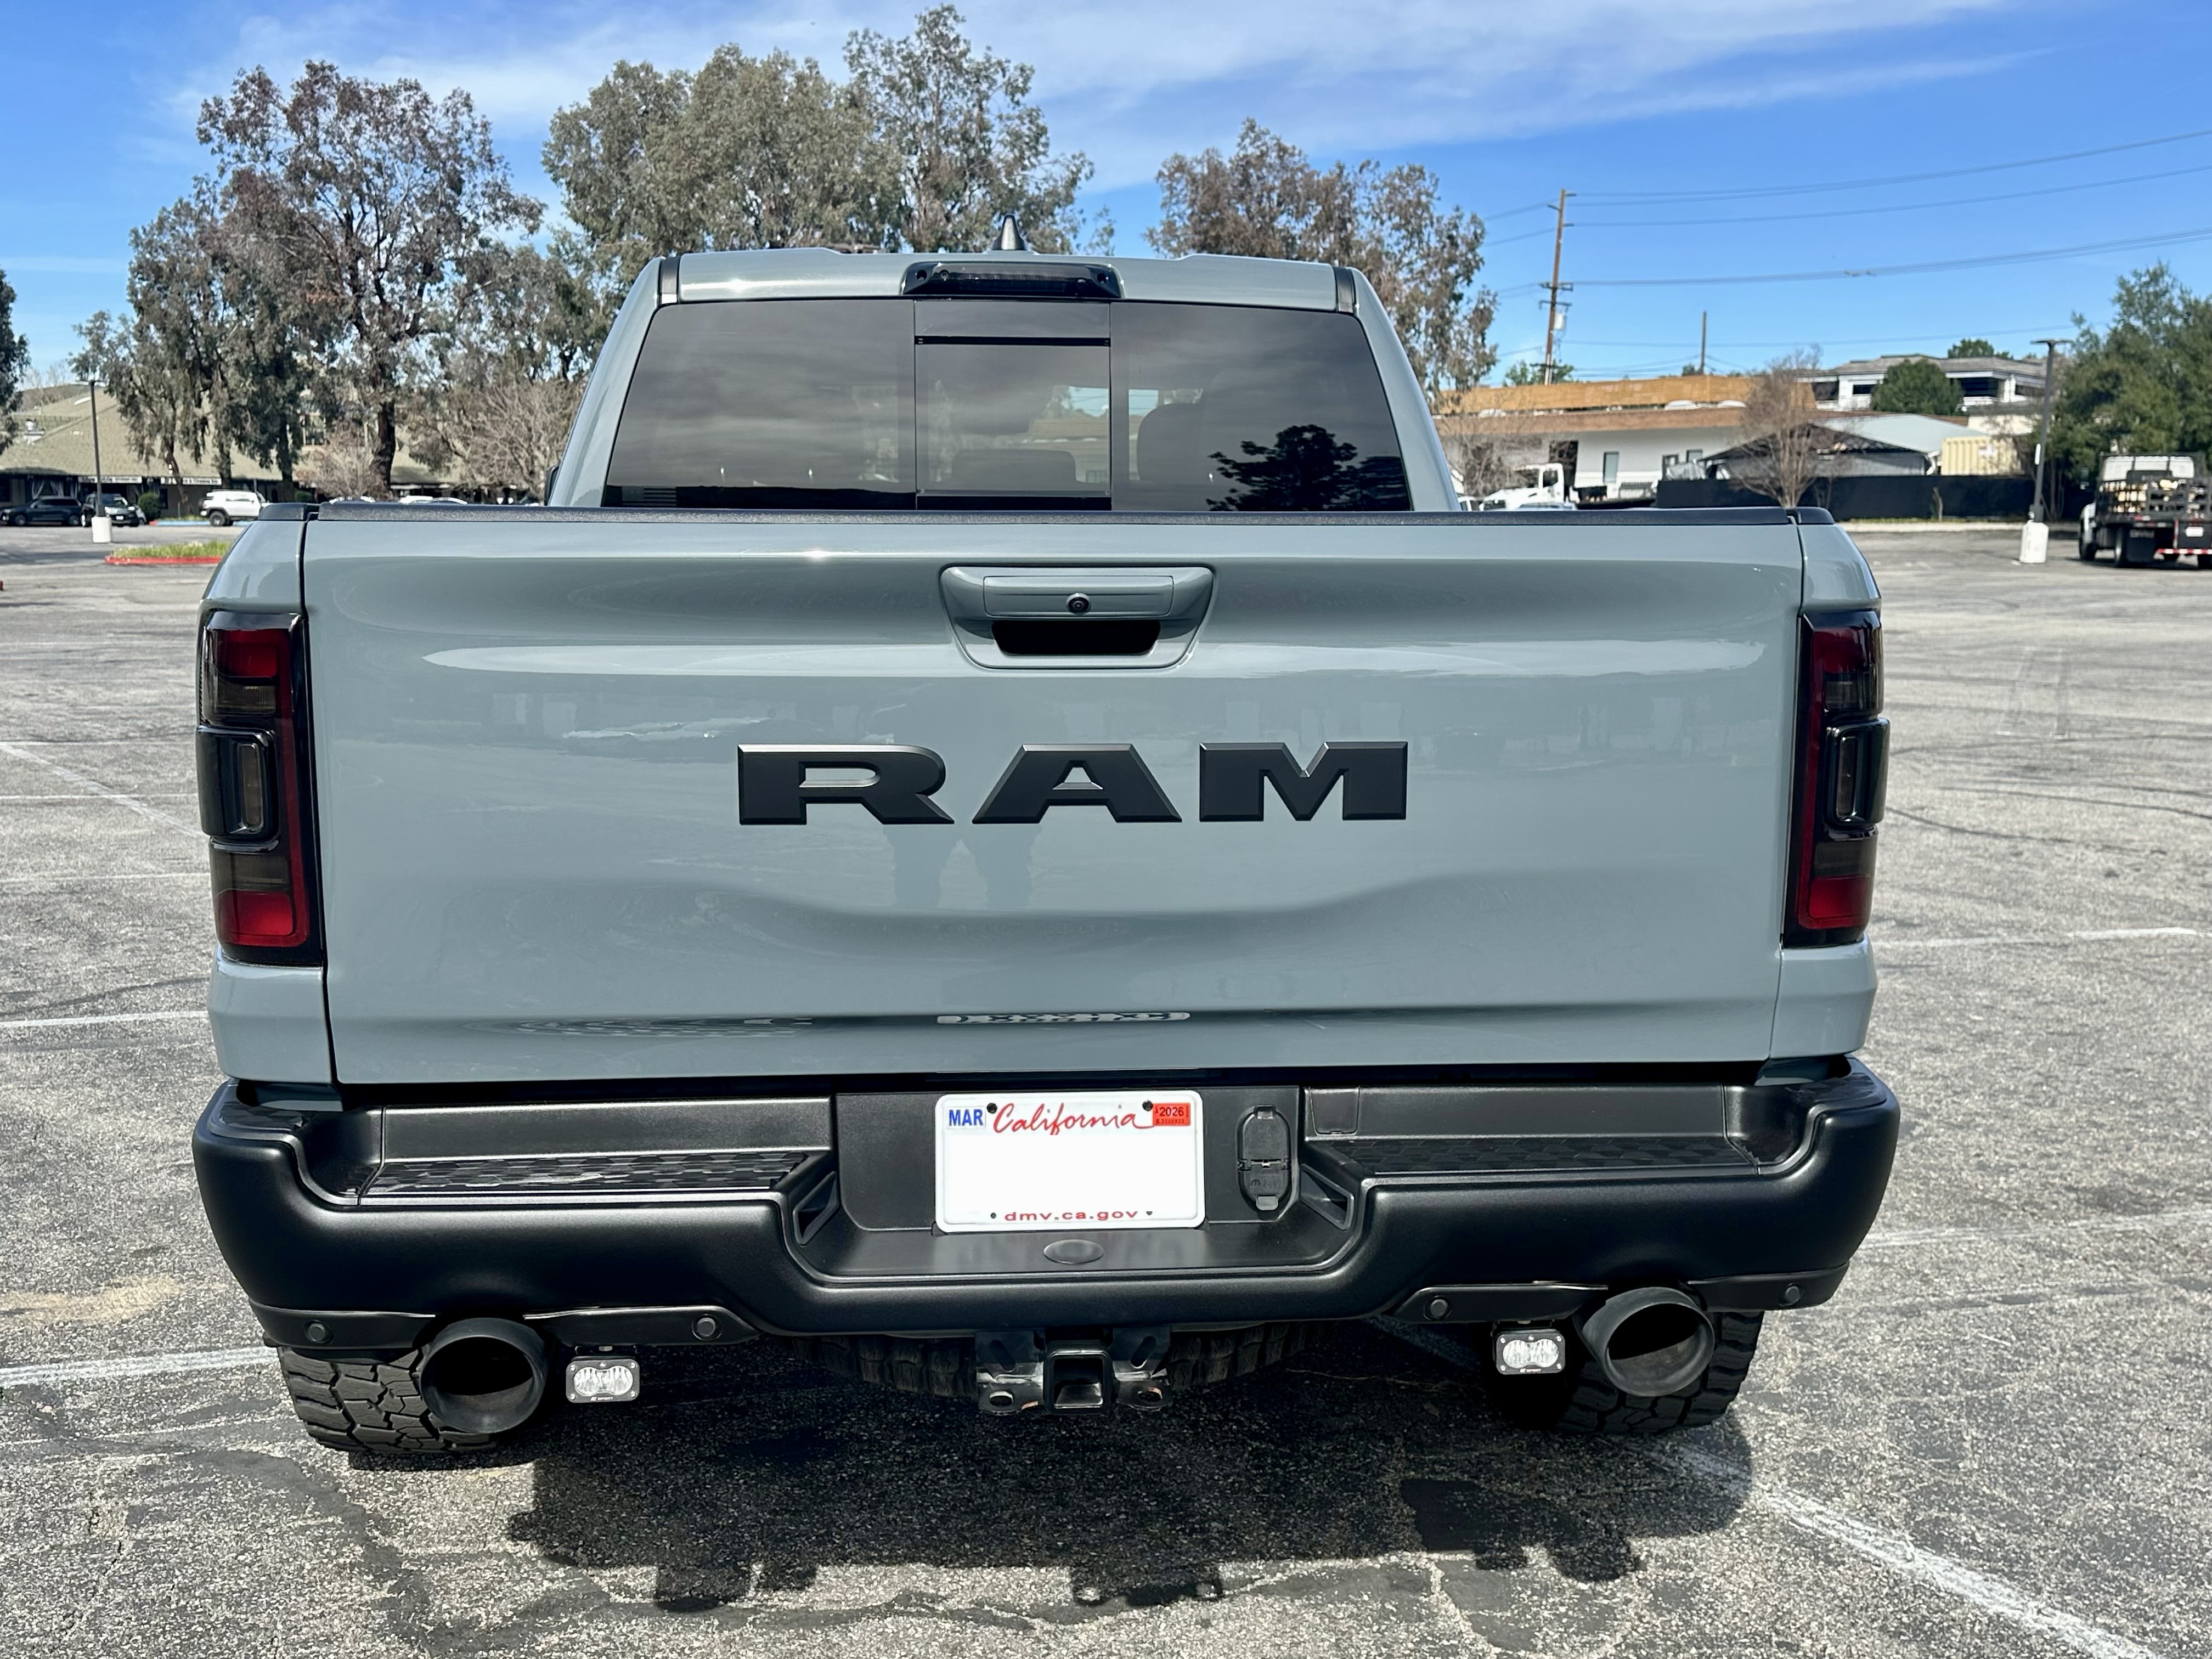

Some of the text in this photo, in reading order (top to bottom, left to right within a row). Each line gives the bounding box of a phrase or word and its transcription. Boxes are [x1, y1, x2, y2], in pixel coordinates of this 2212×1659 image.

[737, 742, 1408, 825] RAM
[949, 1109, 984, 1126] MAR
[993, 1102, 1154, 1135] California
[1159, 1106, 1184, 1117] 2026
[1005, 1211, 1138, 1221] dmv.ca.gov
